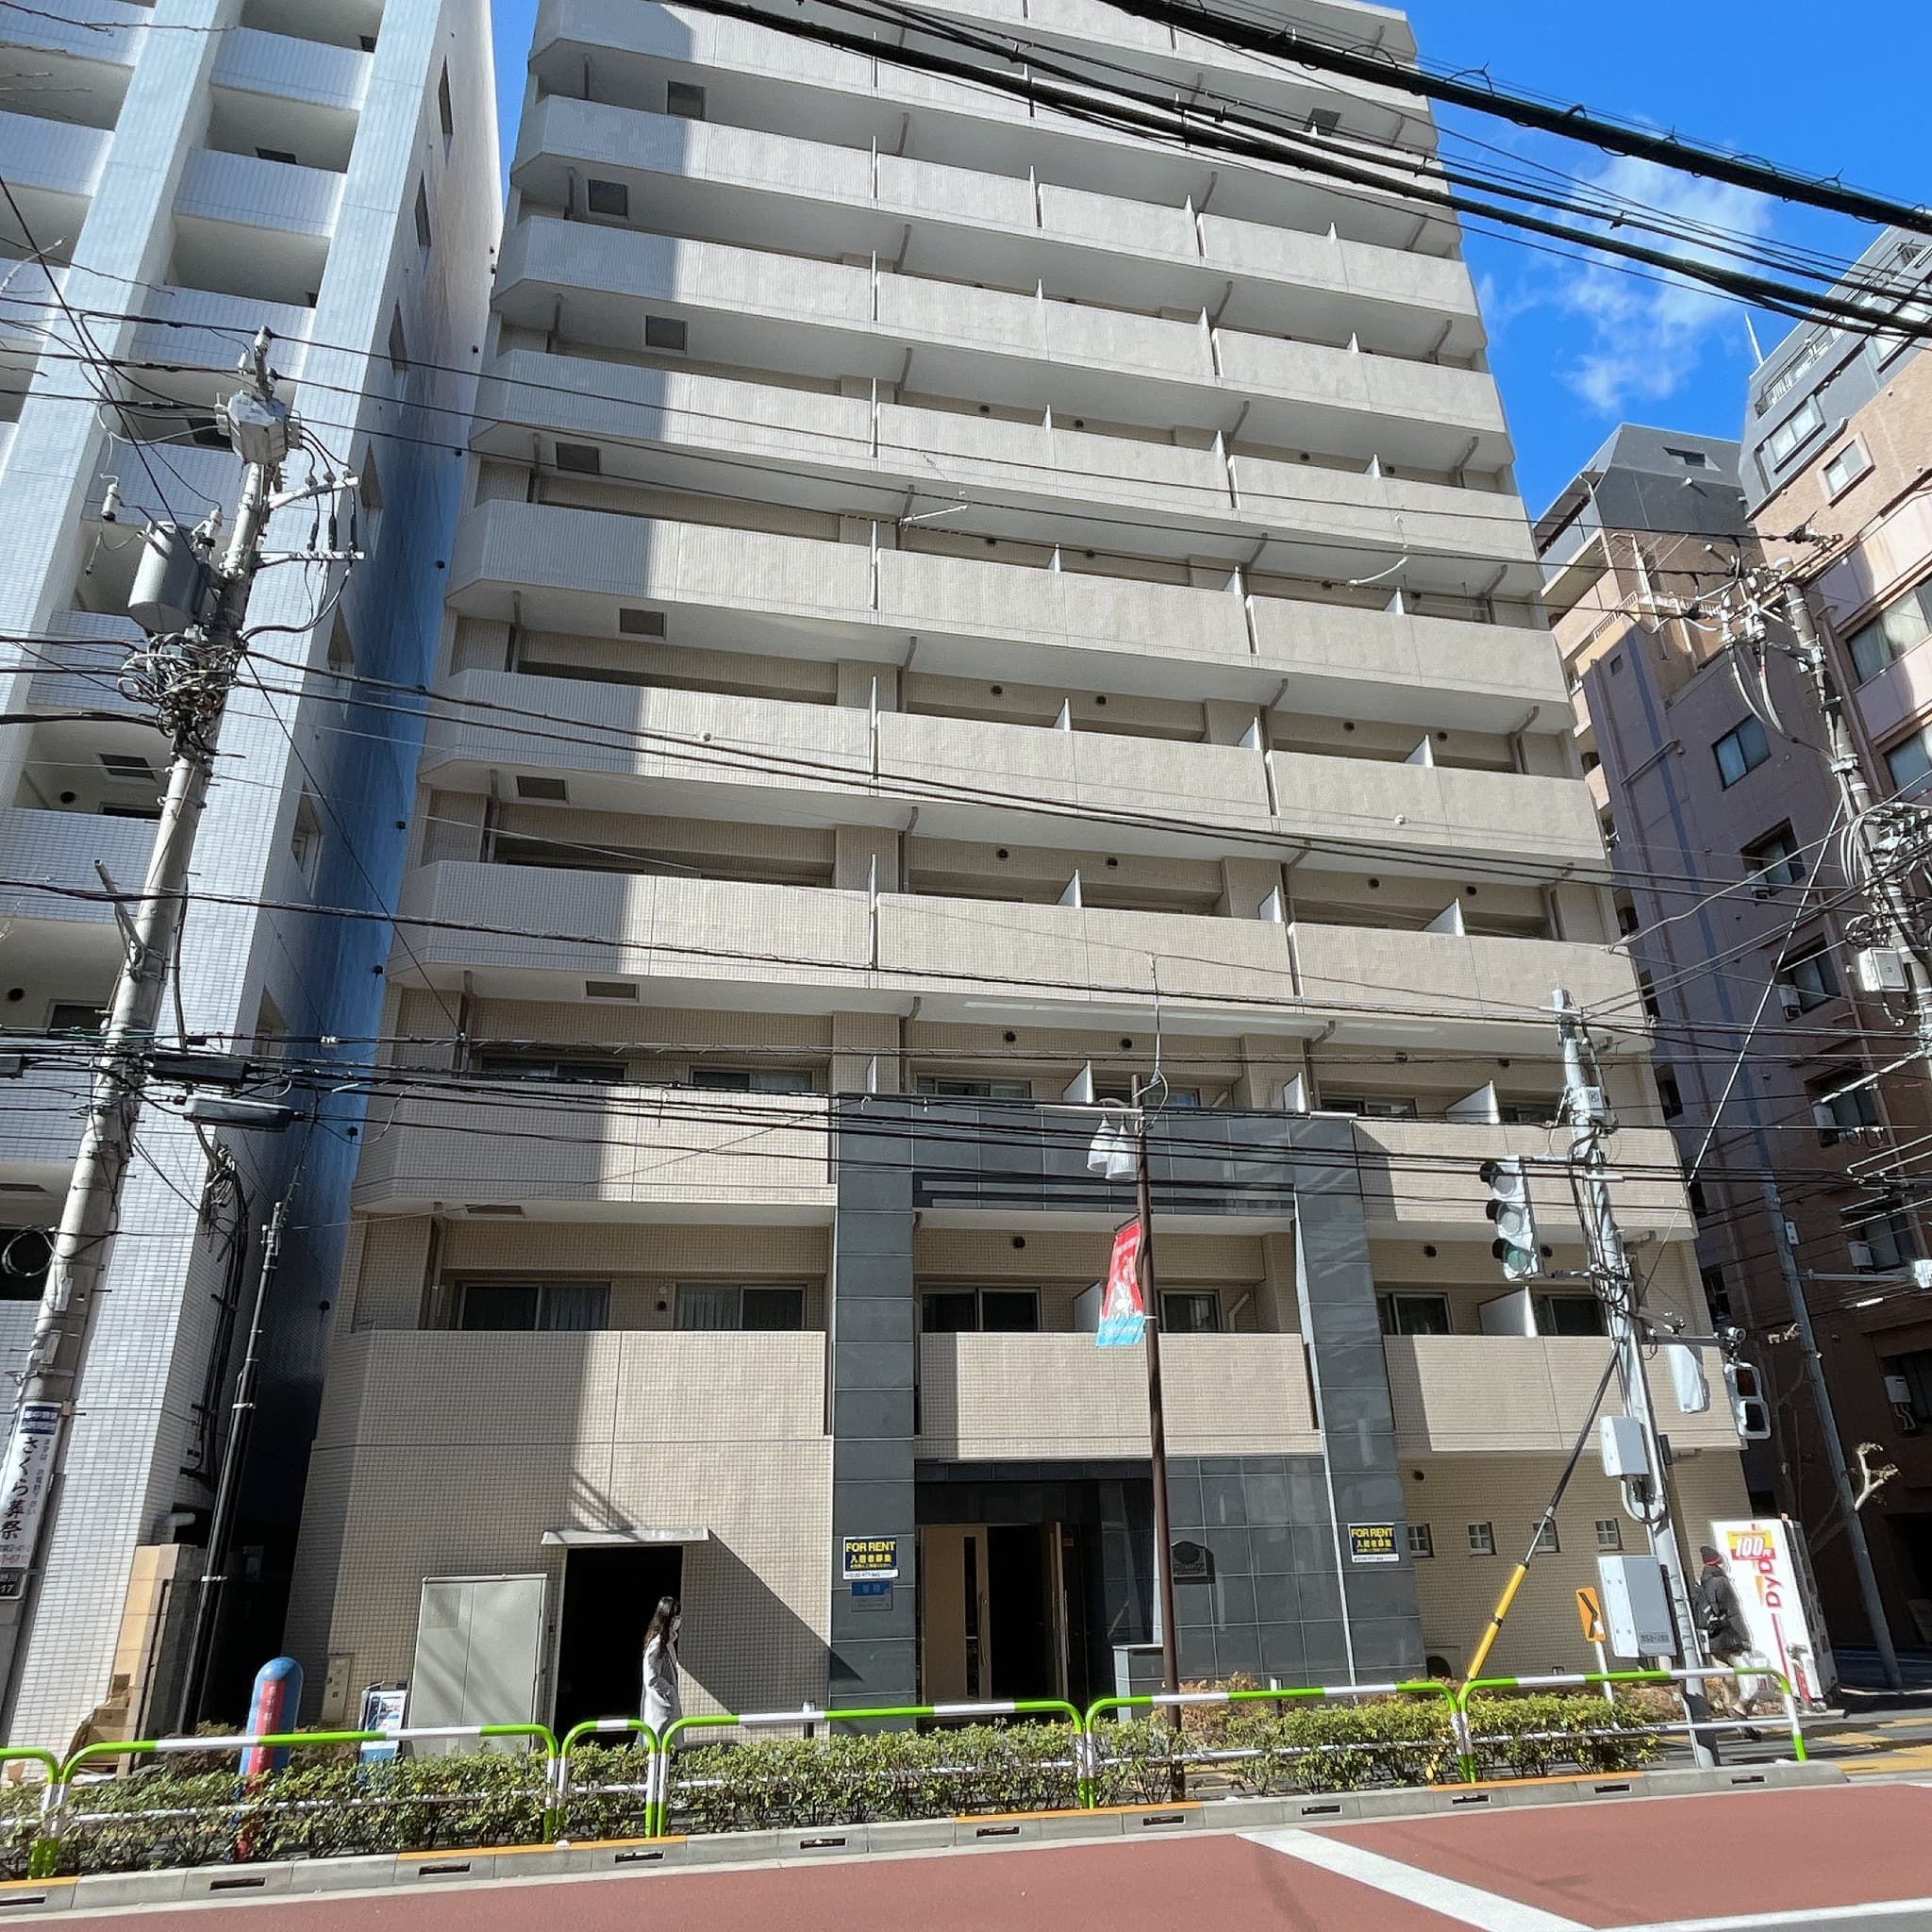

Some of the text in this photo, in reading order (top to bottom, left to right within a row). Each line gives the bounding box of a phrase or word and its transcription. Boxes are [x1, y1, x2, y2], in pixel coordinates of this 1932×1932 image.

[0, 1437, 39, 1541] さくら葬祭
[1351, 1527, 1393, 1538] FOR RENT
[846, 1541, 896, 1553] FOR RENT
